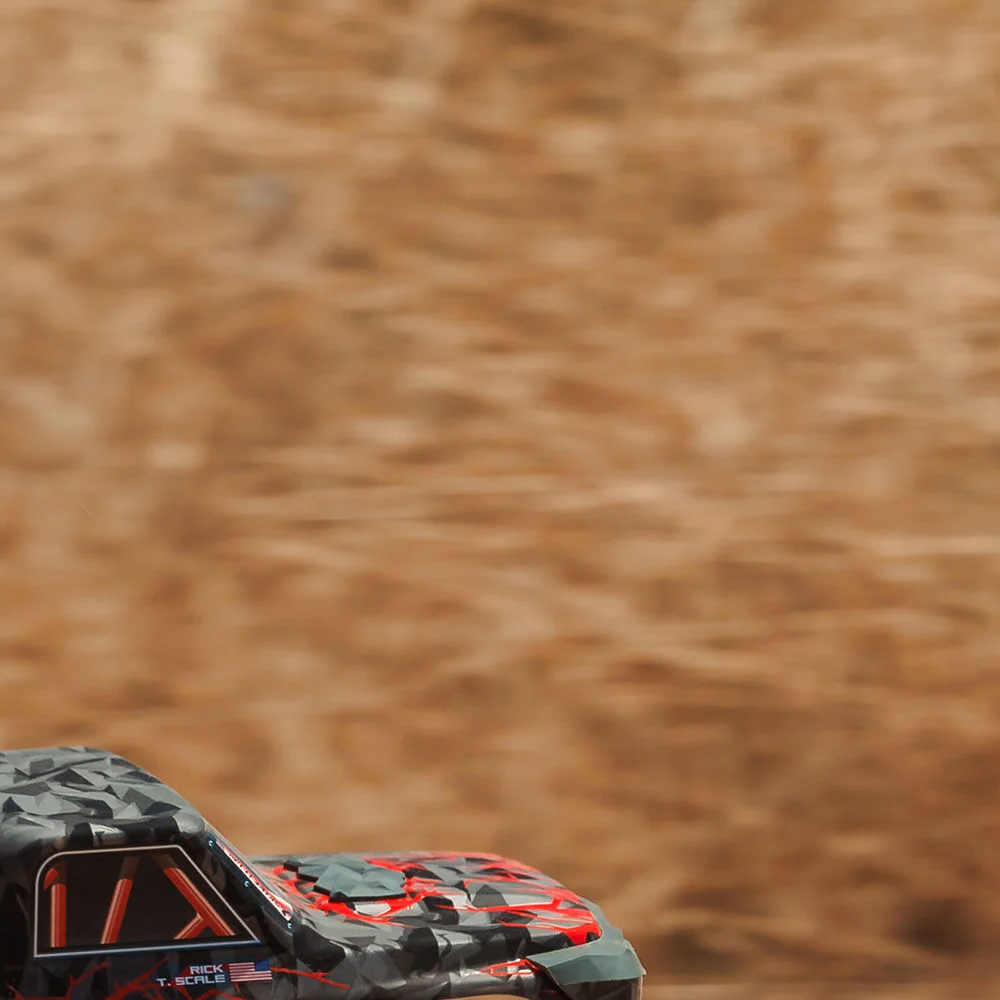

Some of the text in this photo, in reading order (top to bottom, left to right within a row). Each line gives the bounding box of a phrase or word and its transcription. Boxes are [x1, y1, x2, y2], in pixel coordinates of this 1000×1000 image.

[190, 964, 224, 974] RICK
[157, 975, 226, 987] T. SCALE
